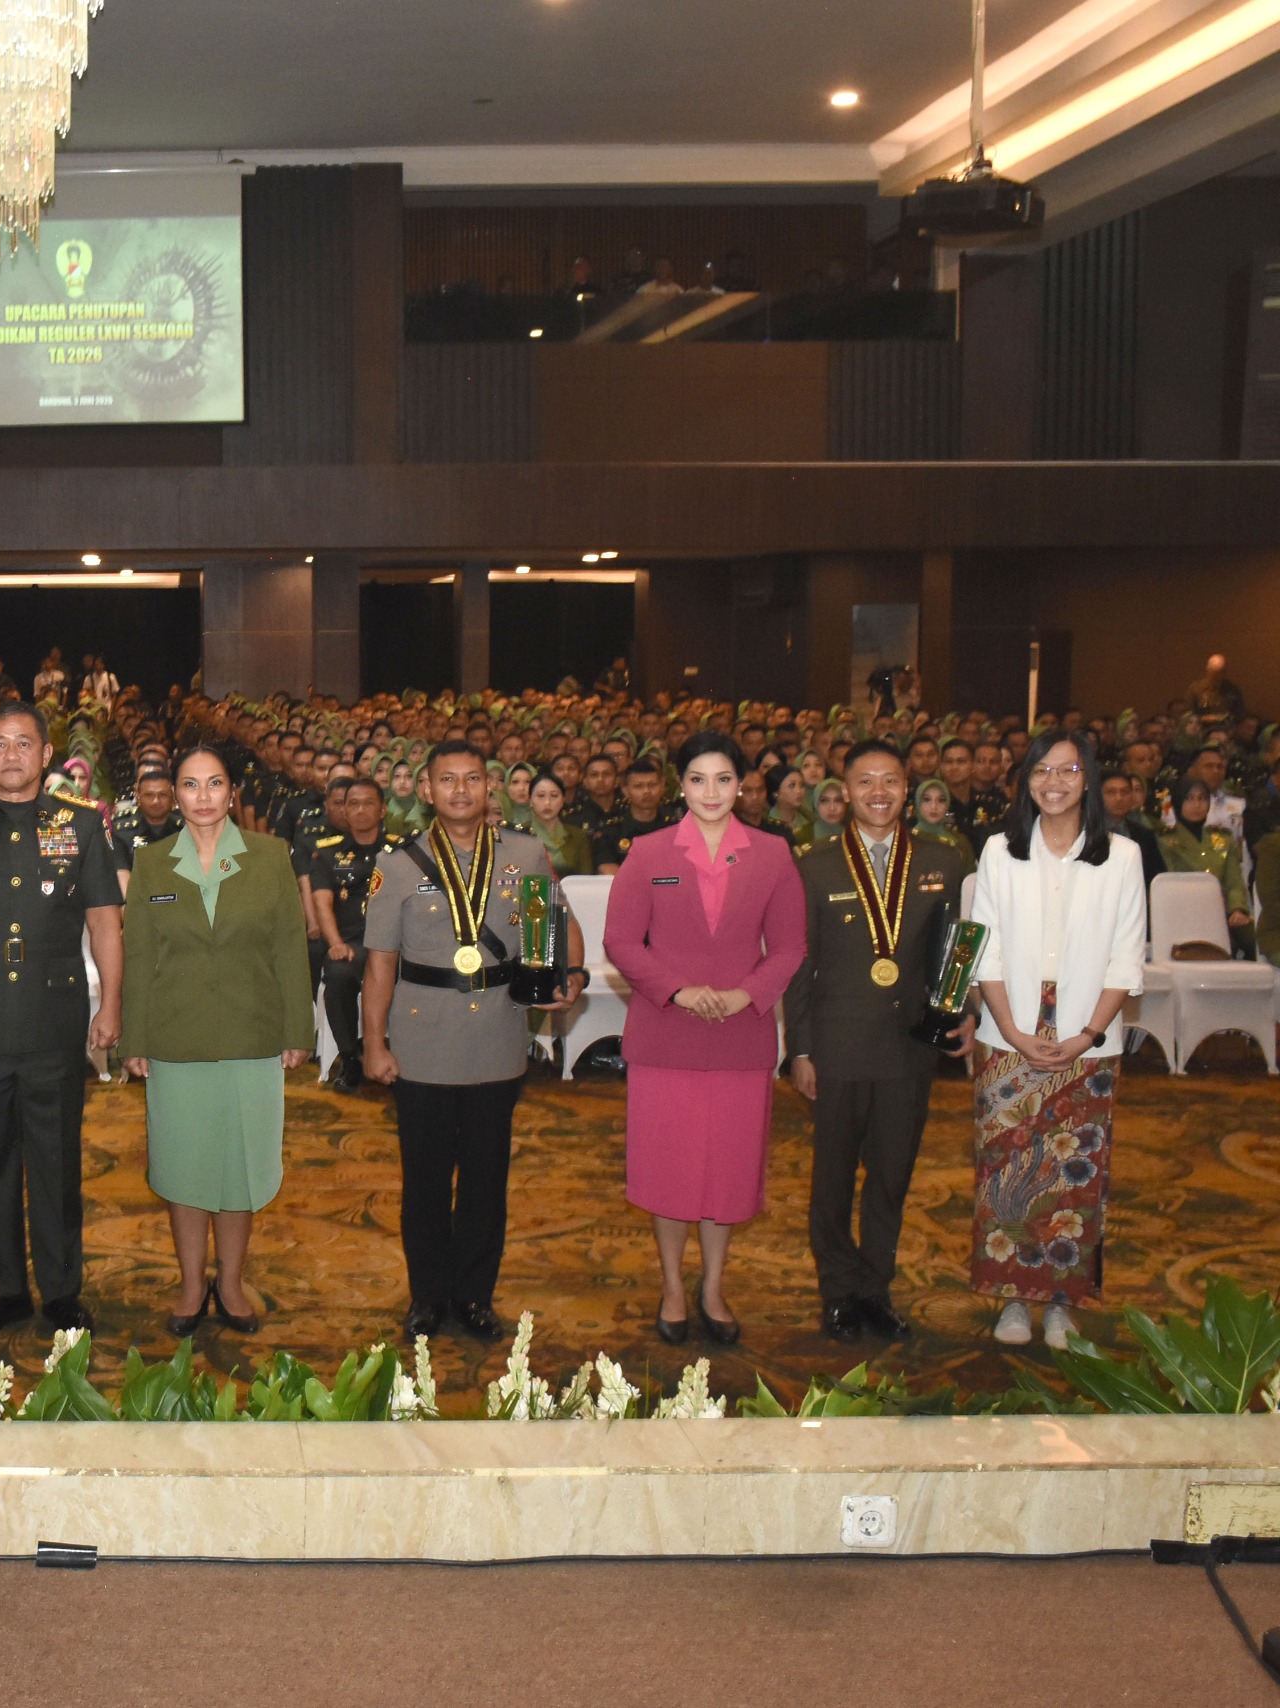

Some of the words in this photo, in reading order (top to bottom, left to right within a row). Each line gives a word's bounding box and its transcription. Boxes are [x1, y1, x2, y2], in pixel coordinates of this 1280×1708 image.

[5, 304, 67, 322] UPACARA
[68, 302, 146, 321] PENUTUPAN
[38, 324, 97, 343] REGULER
[133, 321, 194, 340] SESKOAD
[49, 347, 66, 364] TA
